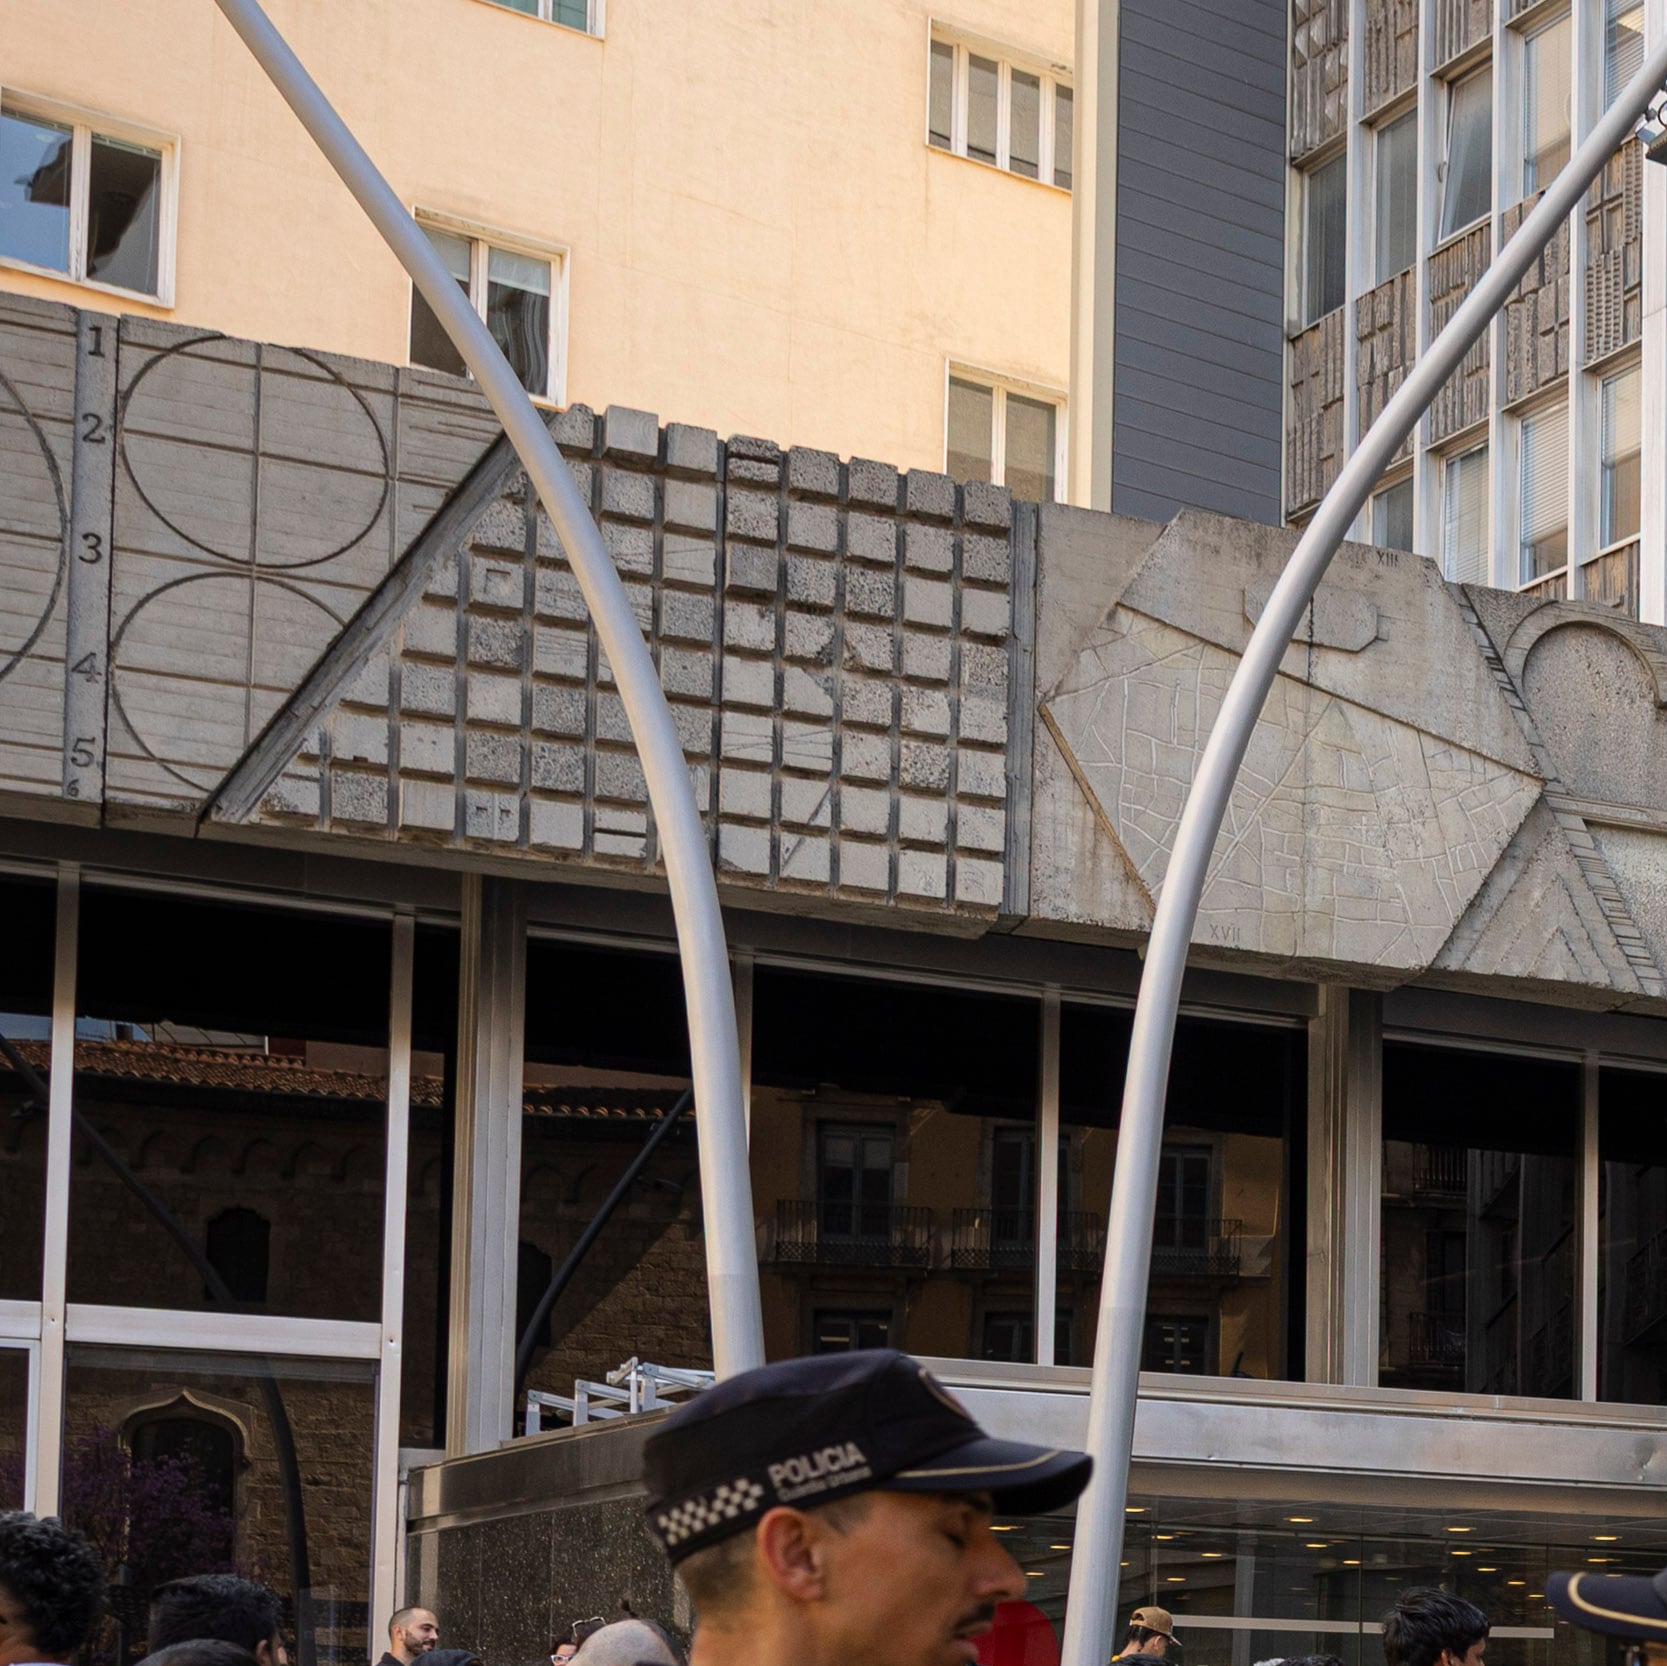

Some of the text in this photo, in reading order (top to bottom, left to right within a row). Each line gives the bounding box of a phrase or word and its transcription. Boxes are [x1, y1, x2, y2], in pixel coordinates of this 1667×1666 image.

[89, 326, 104, 358] 1
[82, 413, 106, 443] 2
[78, 533, 102, 564] 3
[71, 652, 101, 682] 4
[70, 738, 94, 767] 5
[768, 1441, 867, 1489] POLICIA
